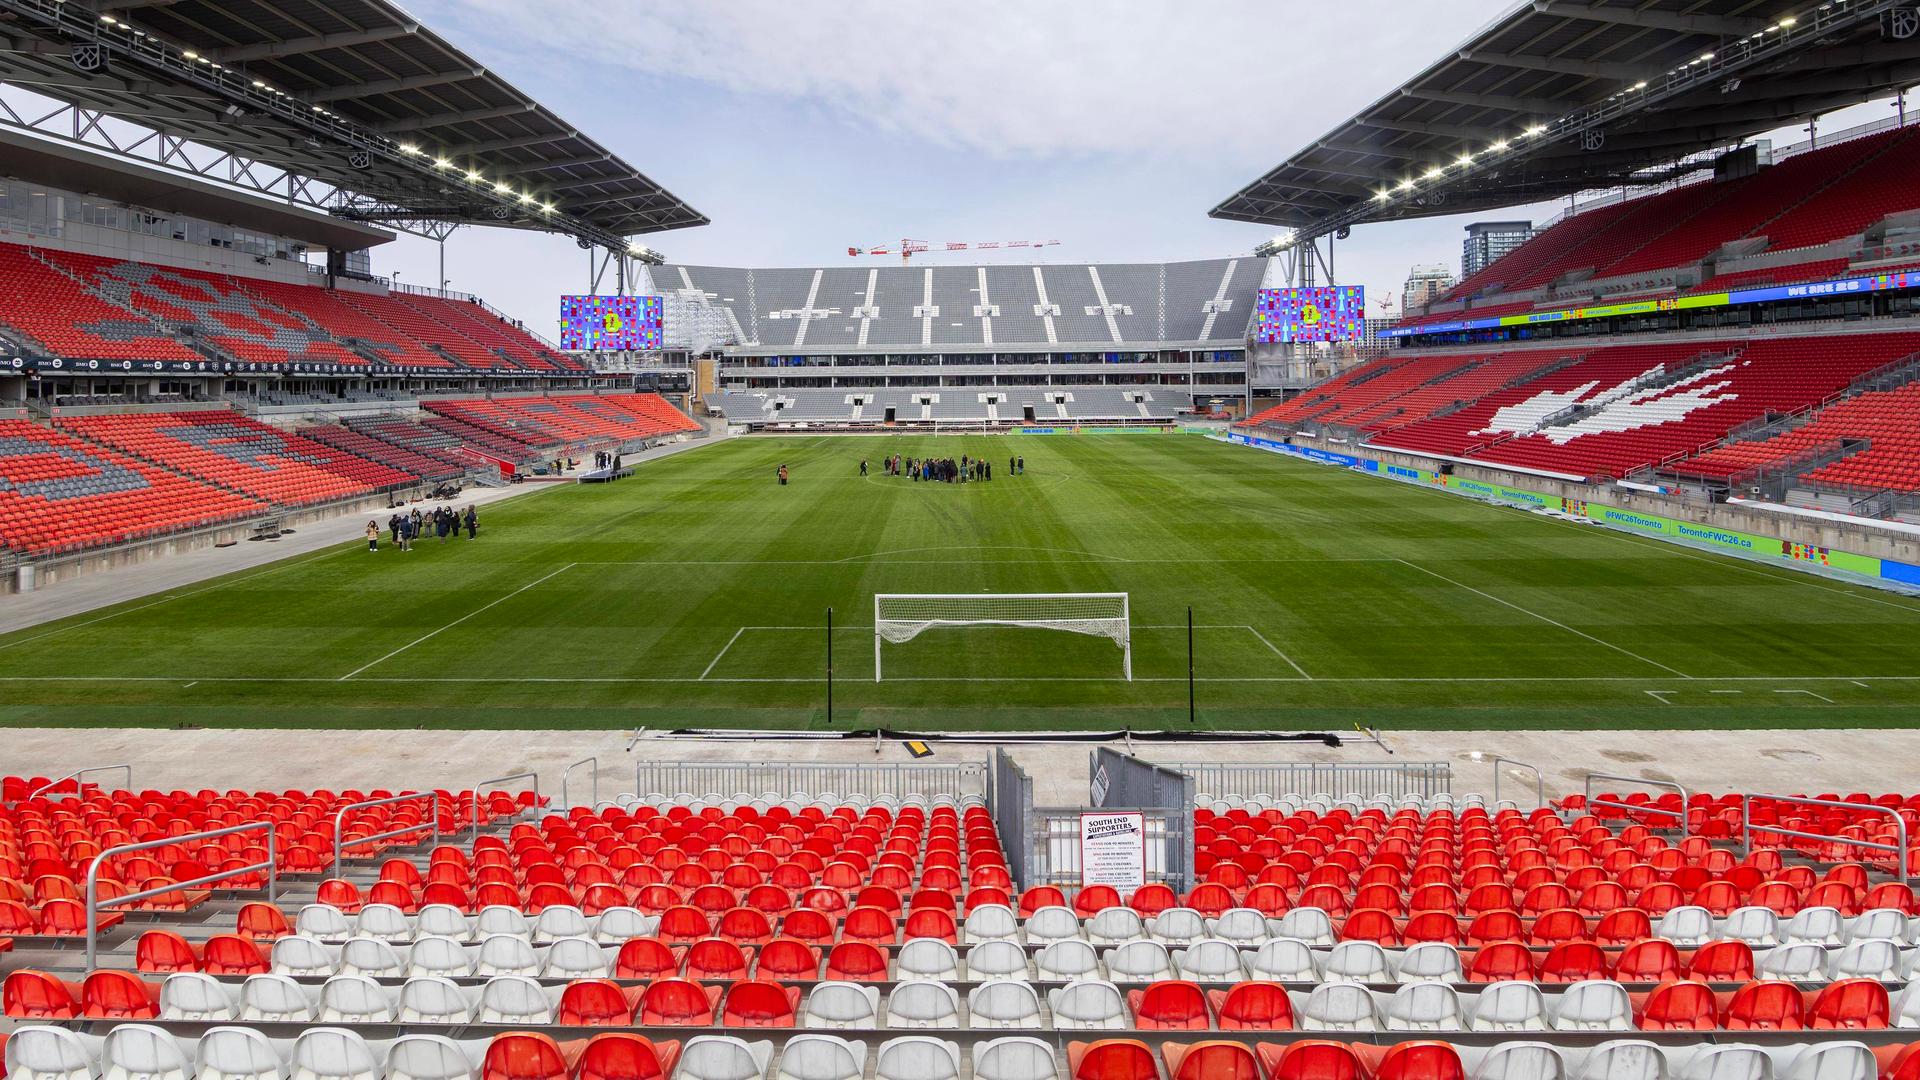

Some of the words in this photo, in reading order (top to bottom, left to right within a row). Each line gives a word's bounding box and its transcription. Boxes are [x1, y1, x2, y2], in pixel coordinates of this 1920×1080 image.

[1788, 287, 1806, 296] WE
[1501, 489, 1543, 503] TorontoFWC26.ca
[1605, 510, 1662, 529] @FWC26Toronto
[1678, 525, 1751, 548] TorontoFWC26.ca
[1088, 819, 1113, 827] SOUTH
[1088, 823, 1132, 833] SUPPORTERS
